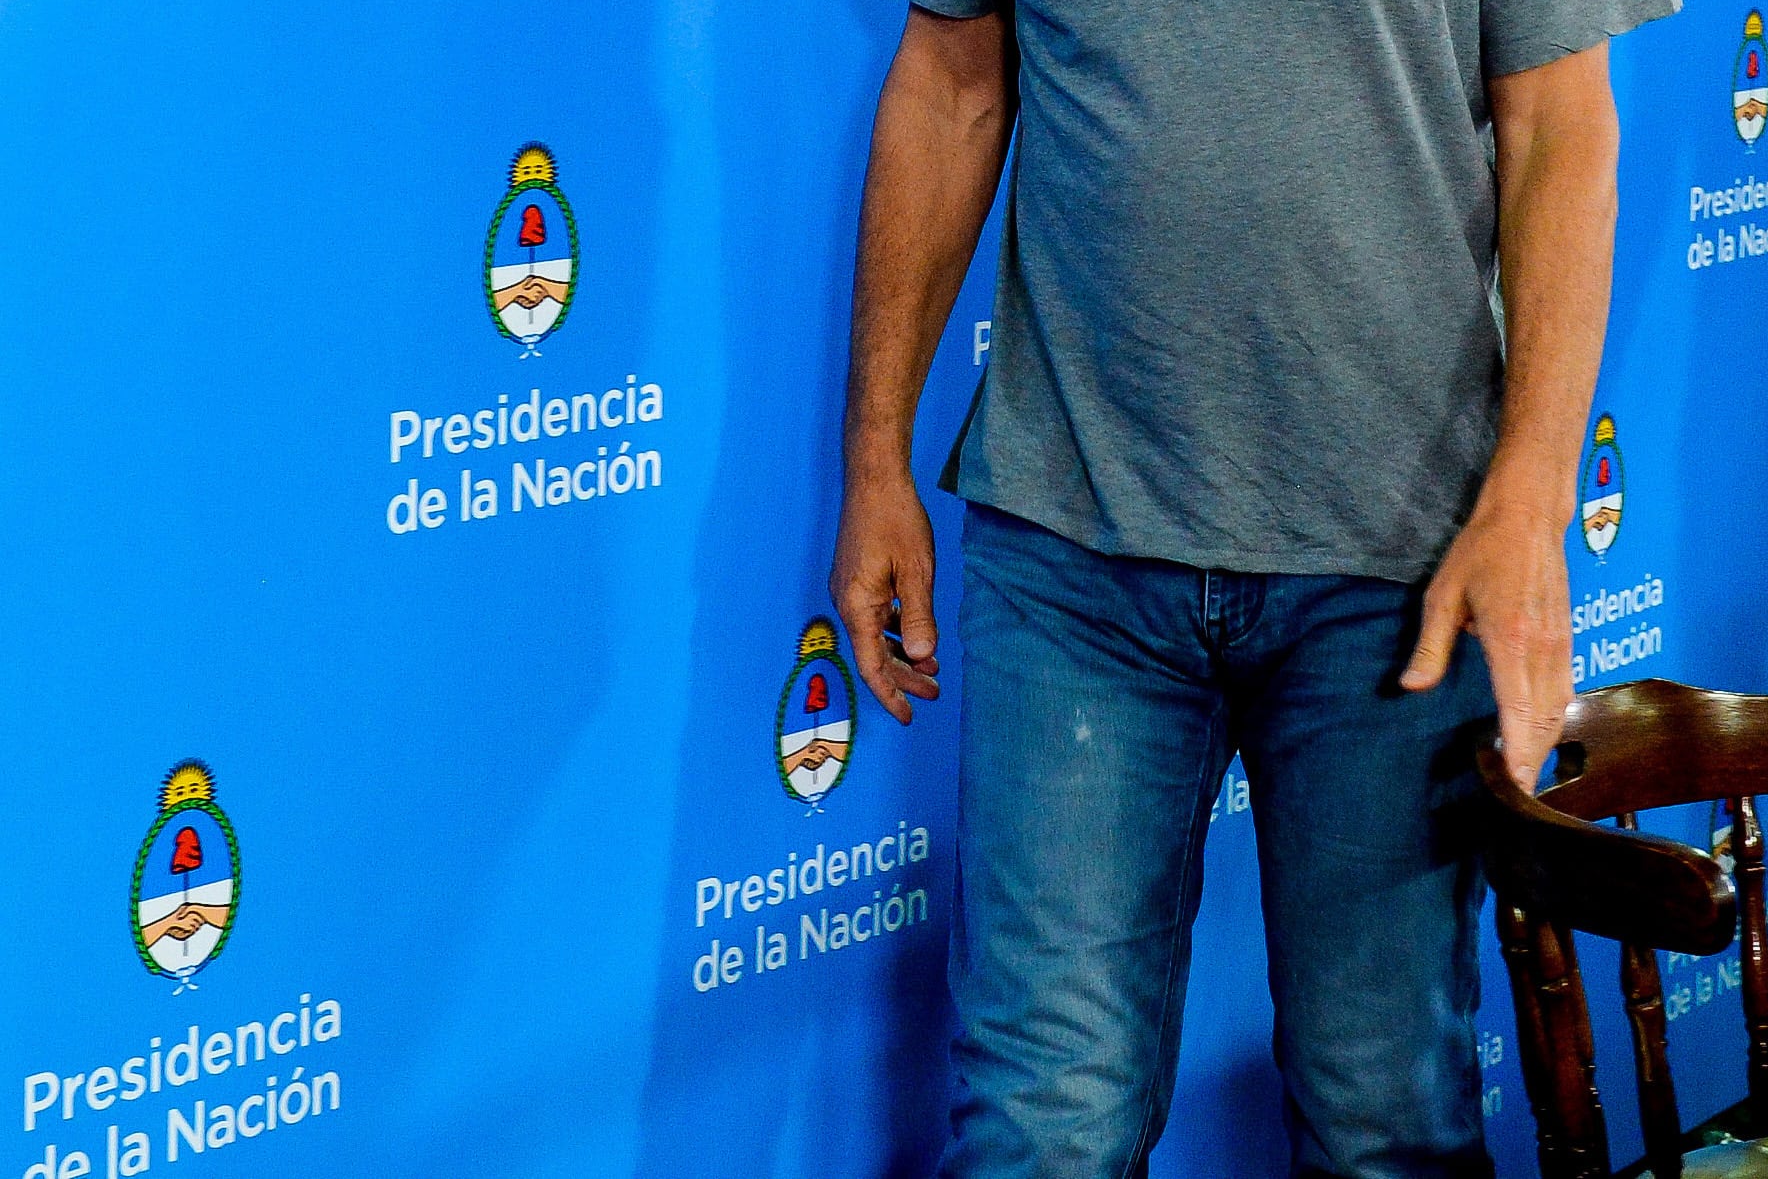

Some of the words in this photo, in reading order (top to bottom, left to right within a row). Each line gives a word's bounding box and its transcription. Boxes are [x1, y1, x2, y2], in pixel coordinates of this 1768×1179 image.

[1687, 233, 1714, 270] de
[1718, 229, 1735, 263] la
[390, 374, 663, 463] Presidencia
[386, 478, 447, 535] de
[460, 469, 498, 522] la
[511, 441, 662, 512] Nación
[1572, 573, 1663, 634] sidencia
[1590, 622, 1662, 677] Nación
[696, 821, 929, 928] Presidencia
[693, 939, 745, 992] de
[755, 926, 787, 974] la
[799, 884, 928, 960] Nación
[24, 992, 342, 1132] Presidencia
[107, 1125, 150, 1179] la
[167, 1066, 340, 1163] Nación
